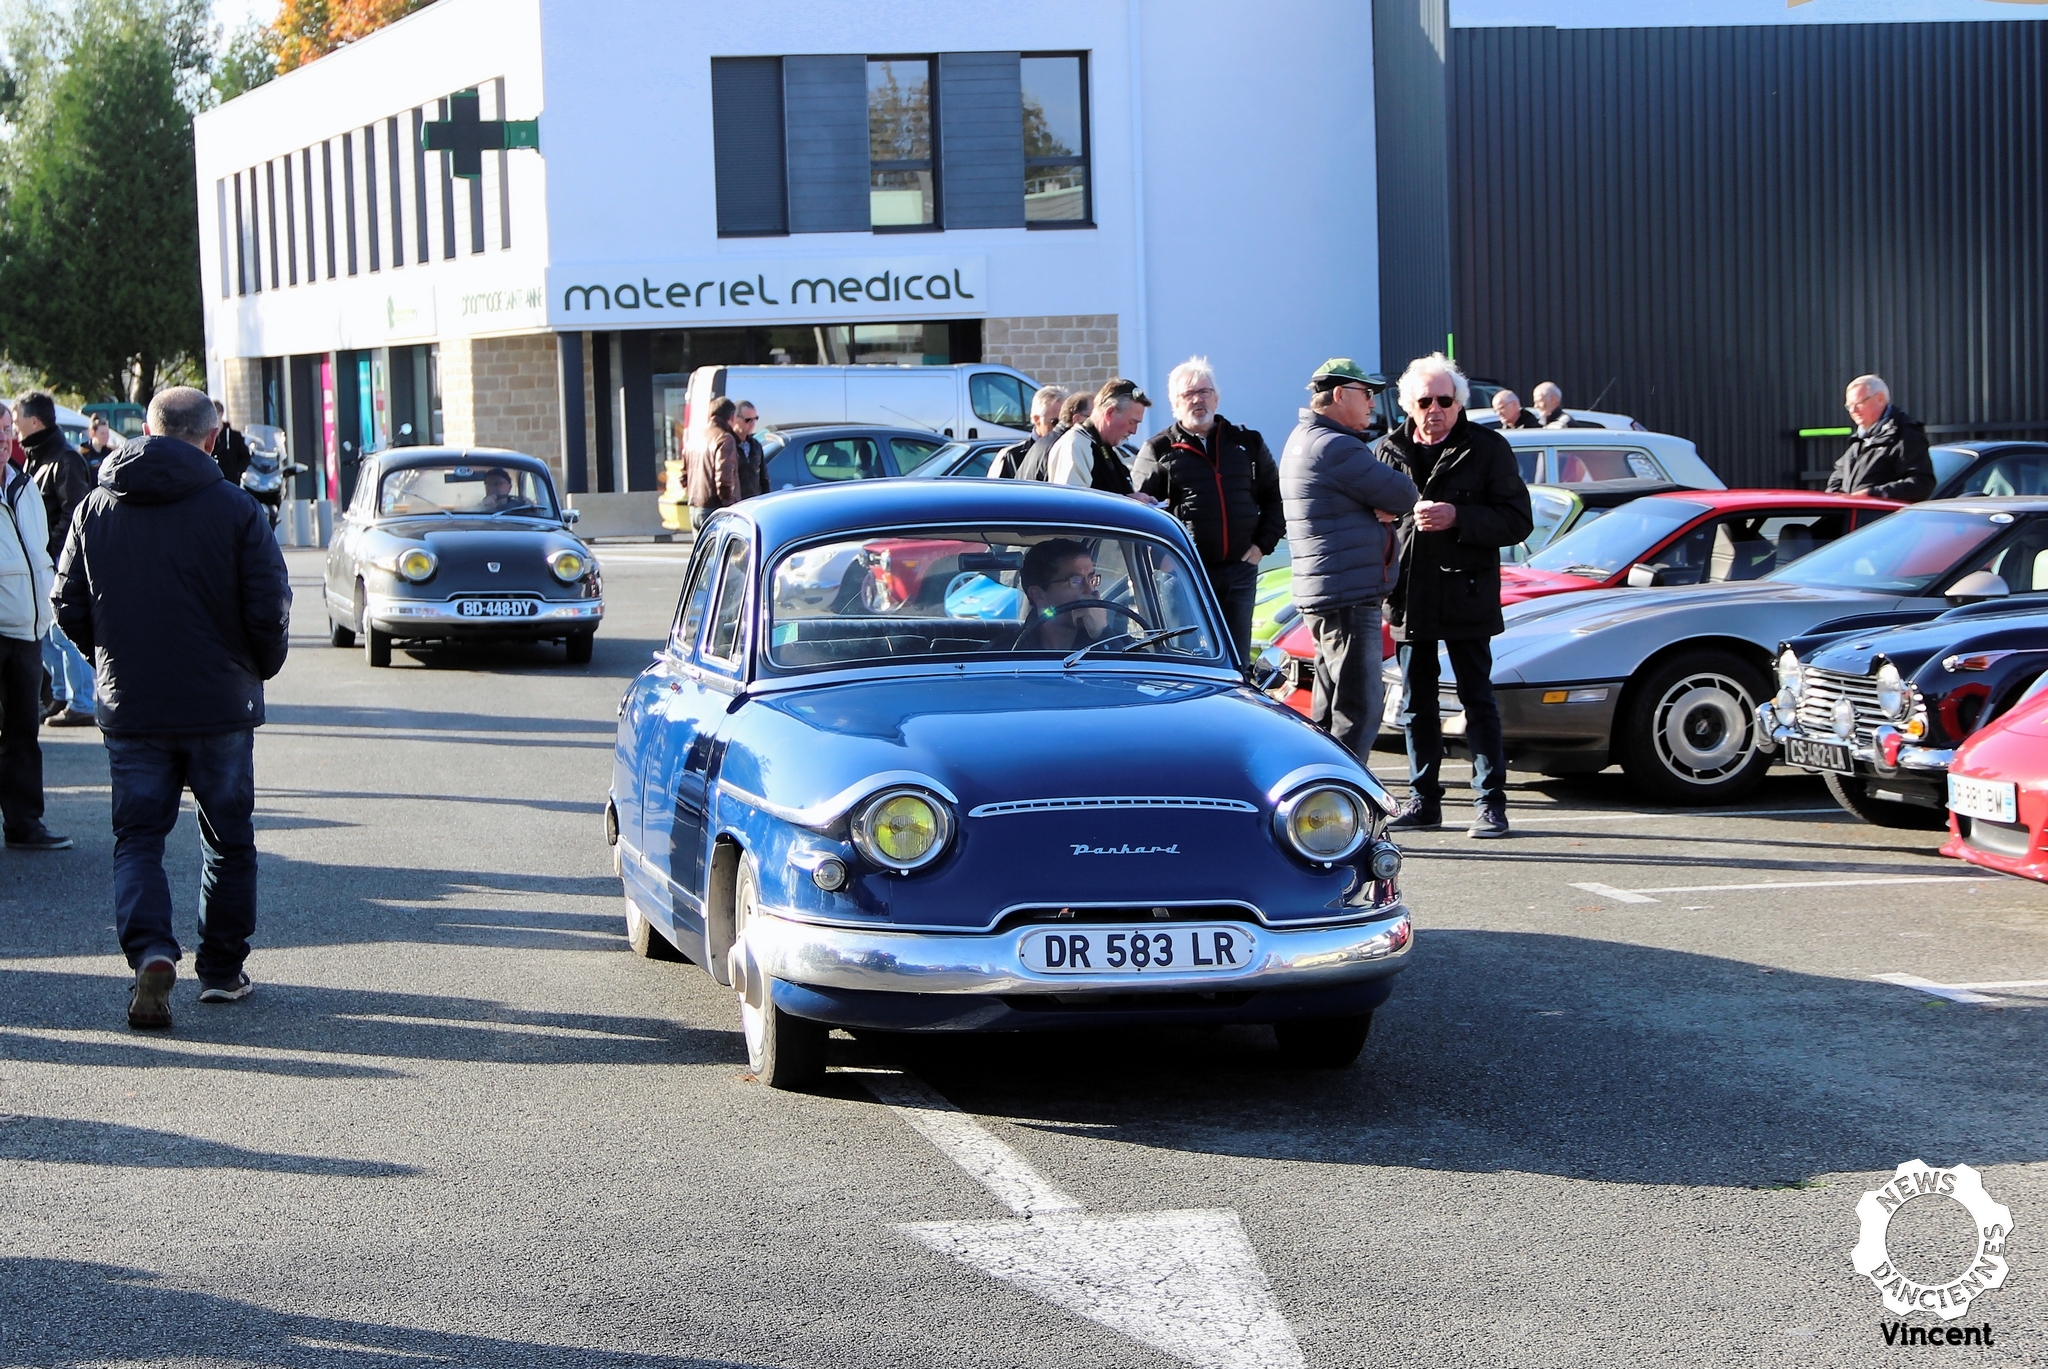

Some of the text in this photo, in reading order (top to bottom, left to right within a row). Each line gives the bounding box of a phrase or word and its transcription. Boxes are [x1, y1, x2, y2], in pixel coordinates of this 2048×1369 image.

[564, 268, 974, 311] materiel medical
[462, 601, 532, 616] BD-448-DY
[1069, 843, 1181, 856] Panhard
[1045, 931, 1237, 968] DR 583 LR
